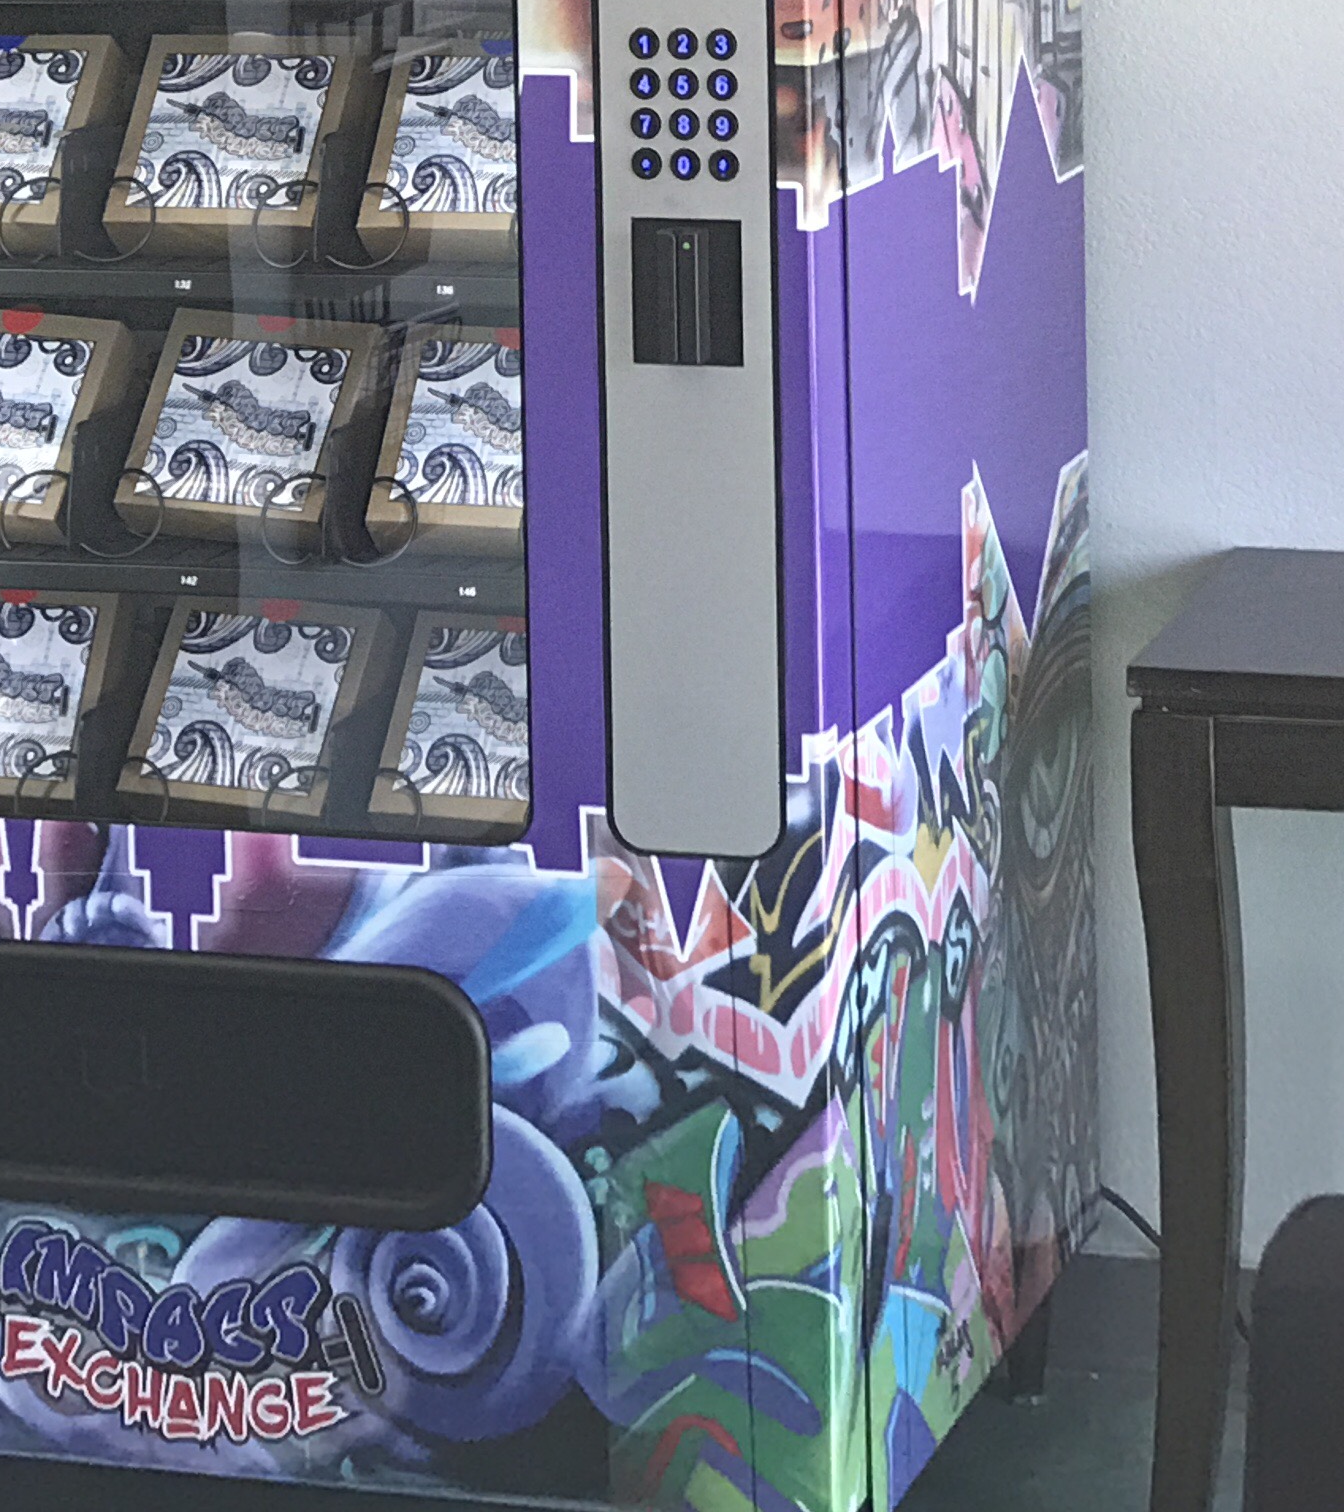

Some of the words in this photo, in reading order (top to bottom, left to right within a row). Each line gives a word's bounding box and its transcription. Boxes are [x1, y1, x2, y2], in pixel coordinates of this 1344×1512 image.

[638, 35, 648, 54] 1
[677, 34, 688, 54] 2
[714, 34, 728, 55] 3
[637, 74, 651, 94] 4
[676, 74, 689, 95] 5
[715, 74, 729, 96] 6
[639, 114, 651, 135] 7
[677, 114, 690, 135] 8
[715, 116, 729, 136] 9
[677, 155, 690, 176] 0
[0, 1220, 324, 1367] IMPACT
[0, 1315, 348, 1442] EXCHANGE
